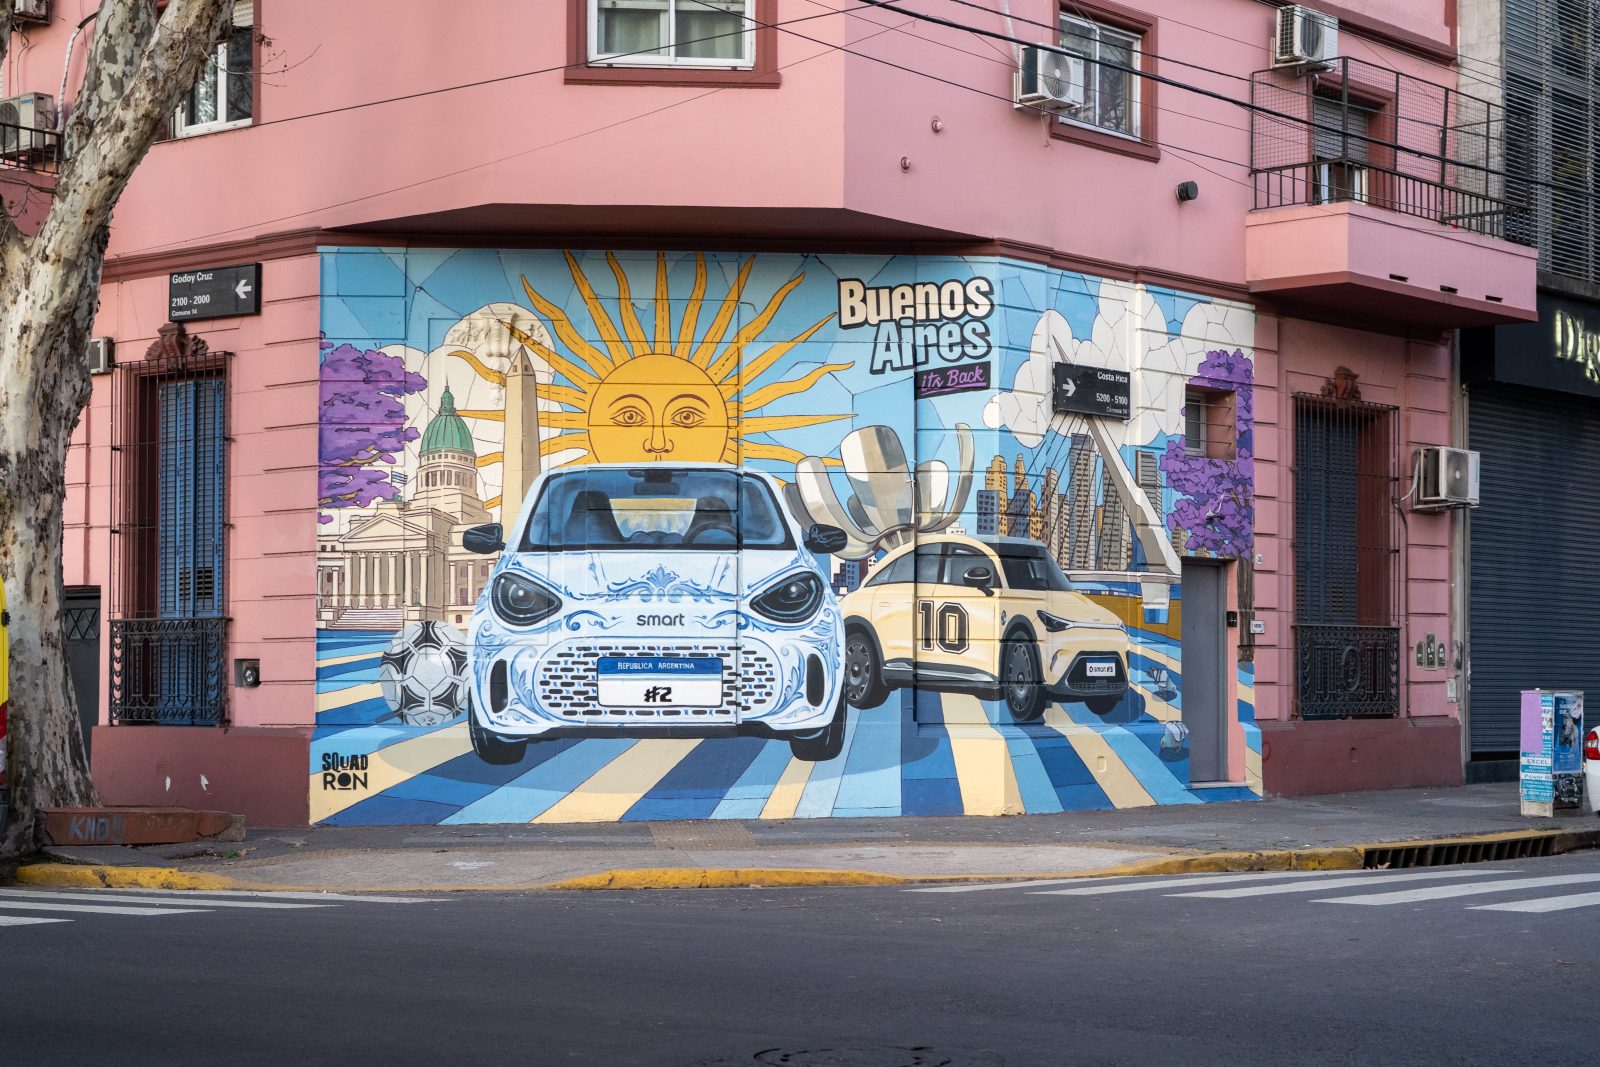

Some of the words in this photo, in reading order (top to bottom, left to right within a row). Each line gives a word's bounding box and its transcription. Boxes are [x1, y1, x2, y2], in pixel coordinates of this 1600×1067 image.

[172, 273, 195, 284] Godoy
[196, 272, 213, 282] Cruz
[172, 296, 188, 307] 2100
[193, 294, 210, 305] 2000
[838, 276, 994, 329] Buenos
[171, 309, 191, 317] Comuna
[870, 317, 992, 374] Aires
[946, 365, 985, 386] Back
[1097, 371, 1115, 382] Costa
[1096, 392, 1111, 403] 5200
[1114, 395, 1128, 406] 5100
[636, 613, 685, 627] smart
[918, 600, 969, 654] 10
[617, 662, 653, 670] REPUBLICA
[658, 662, 695, 670] ARGENTINA
[644, 686, 672, 702] #2
[322, 752, 368, 772] SQUAD
[323, 773, 368, 790] RON
